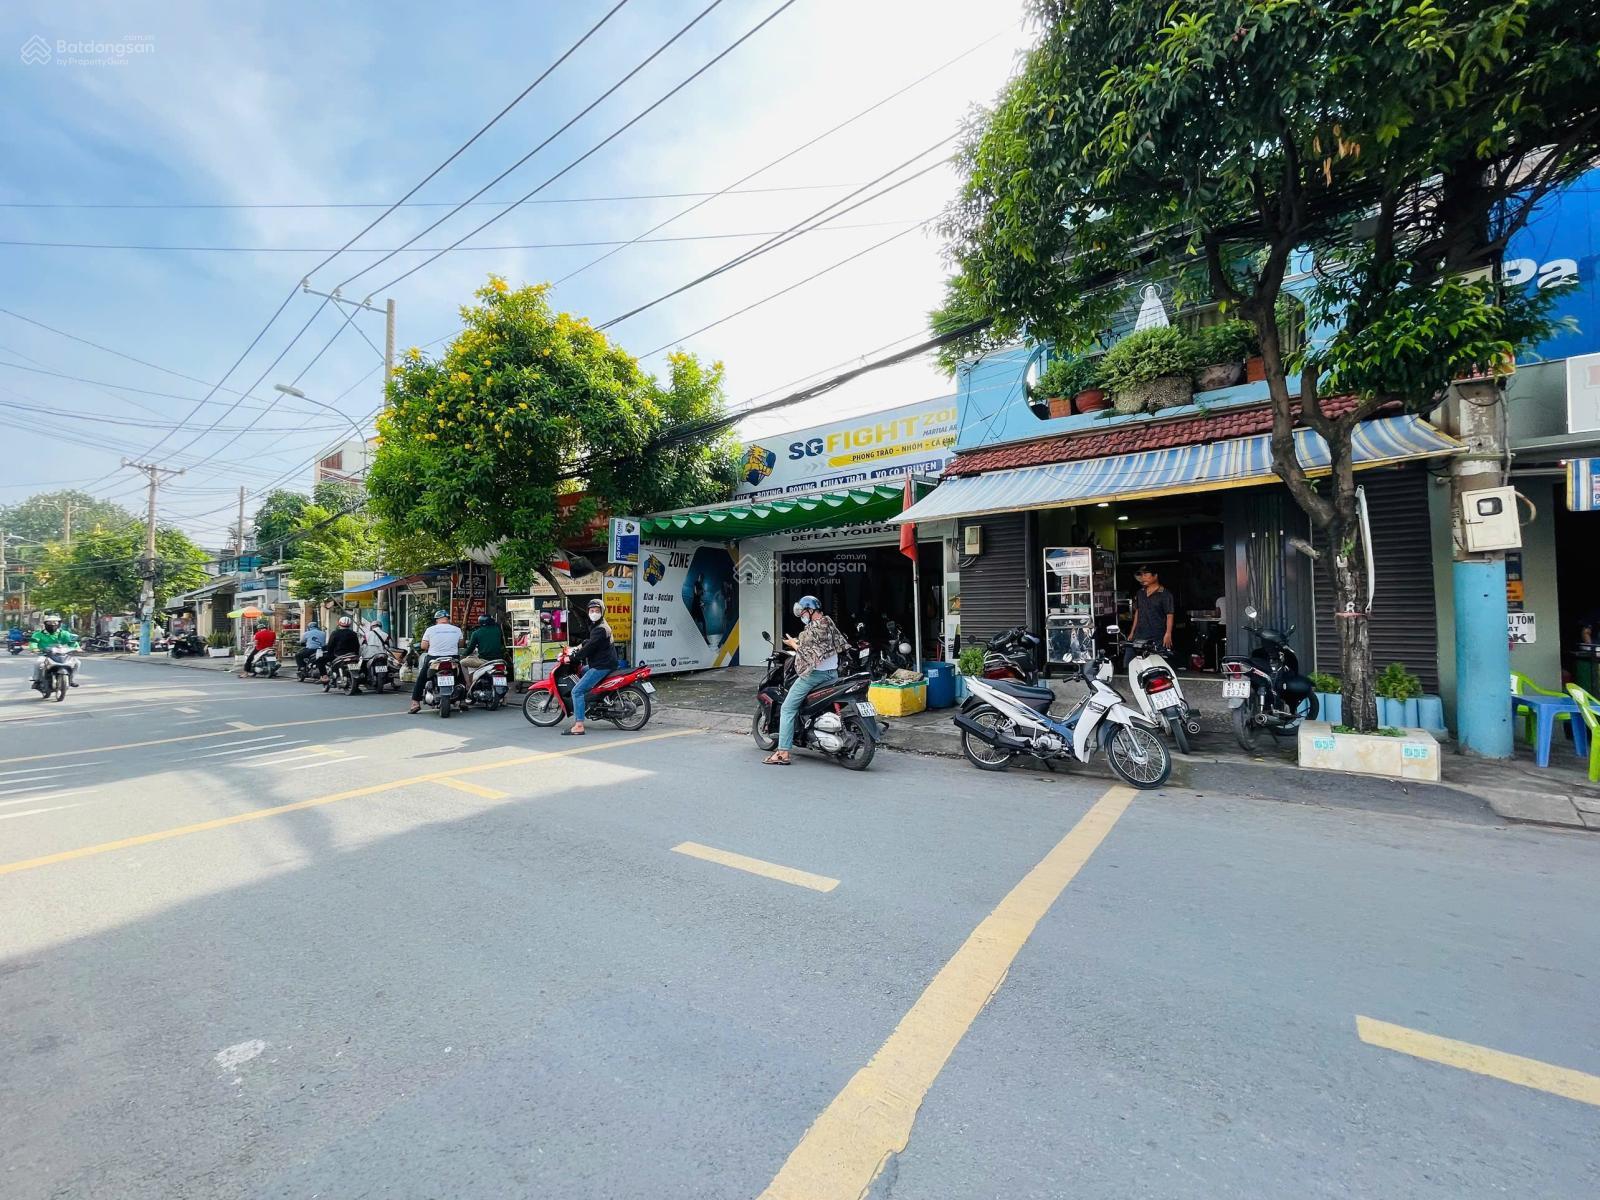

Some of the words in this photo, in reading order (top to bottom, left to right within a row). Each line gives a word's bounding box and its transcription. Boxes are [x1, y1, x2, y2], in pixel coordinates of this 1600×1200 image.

[826, 415, 920, 453] FIGHT
[789, 482, 816, 493] BOXING
[822, 477, 845, 488] MUAY
[791, 530, 837, 542] DEFEAT
[668, 551, 690, 569] ZONE
[643, 617, 657, 626] Muay
